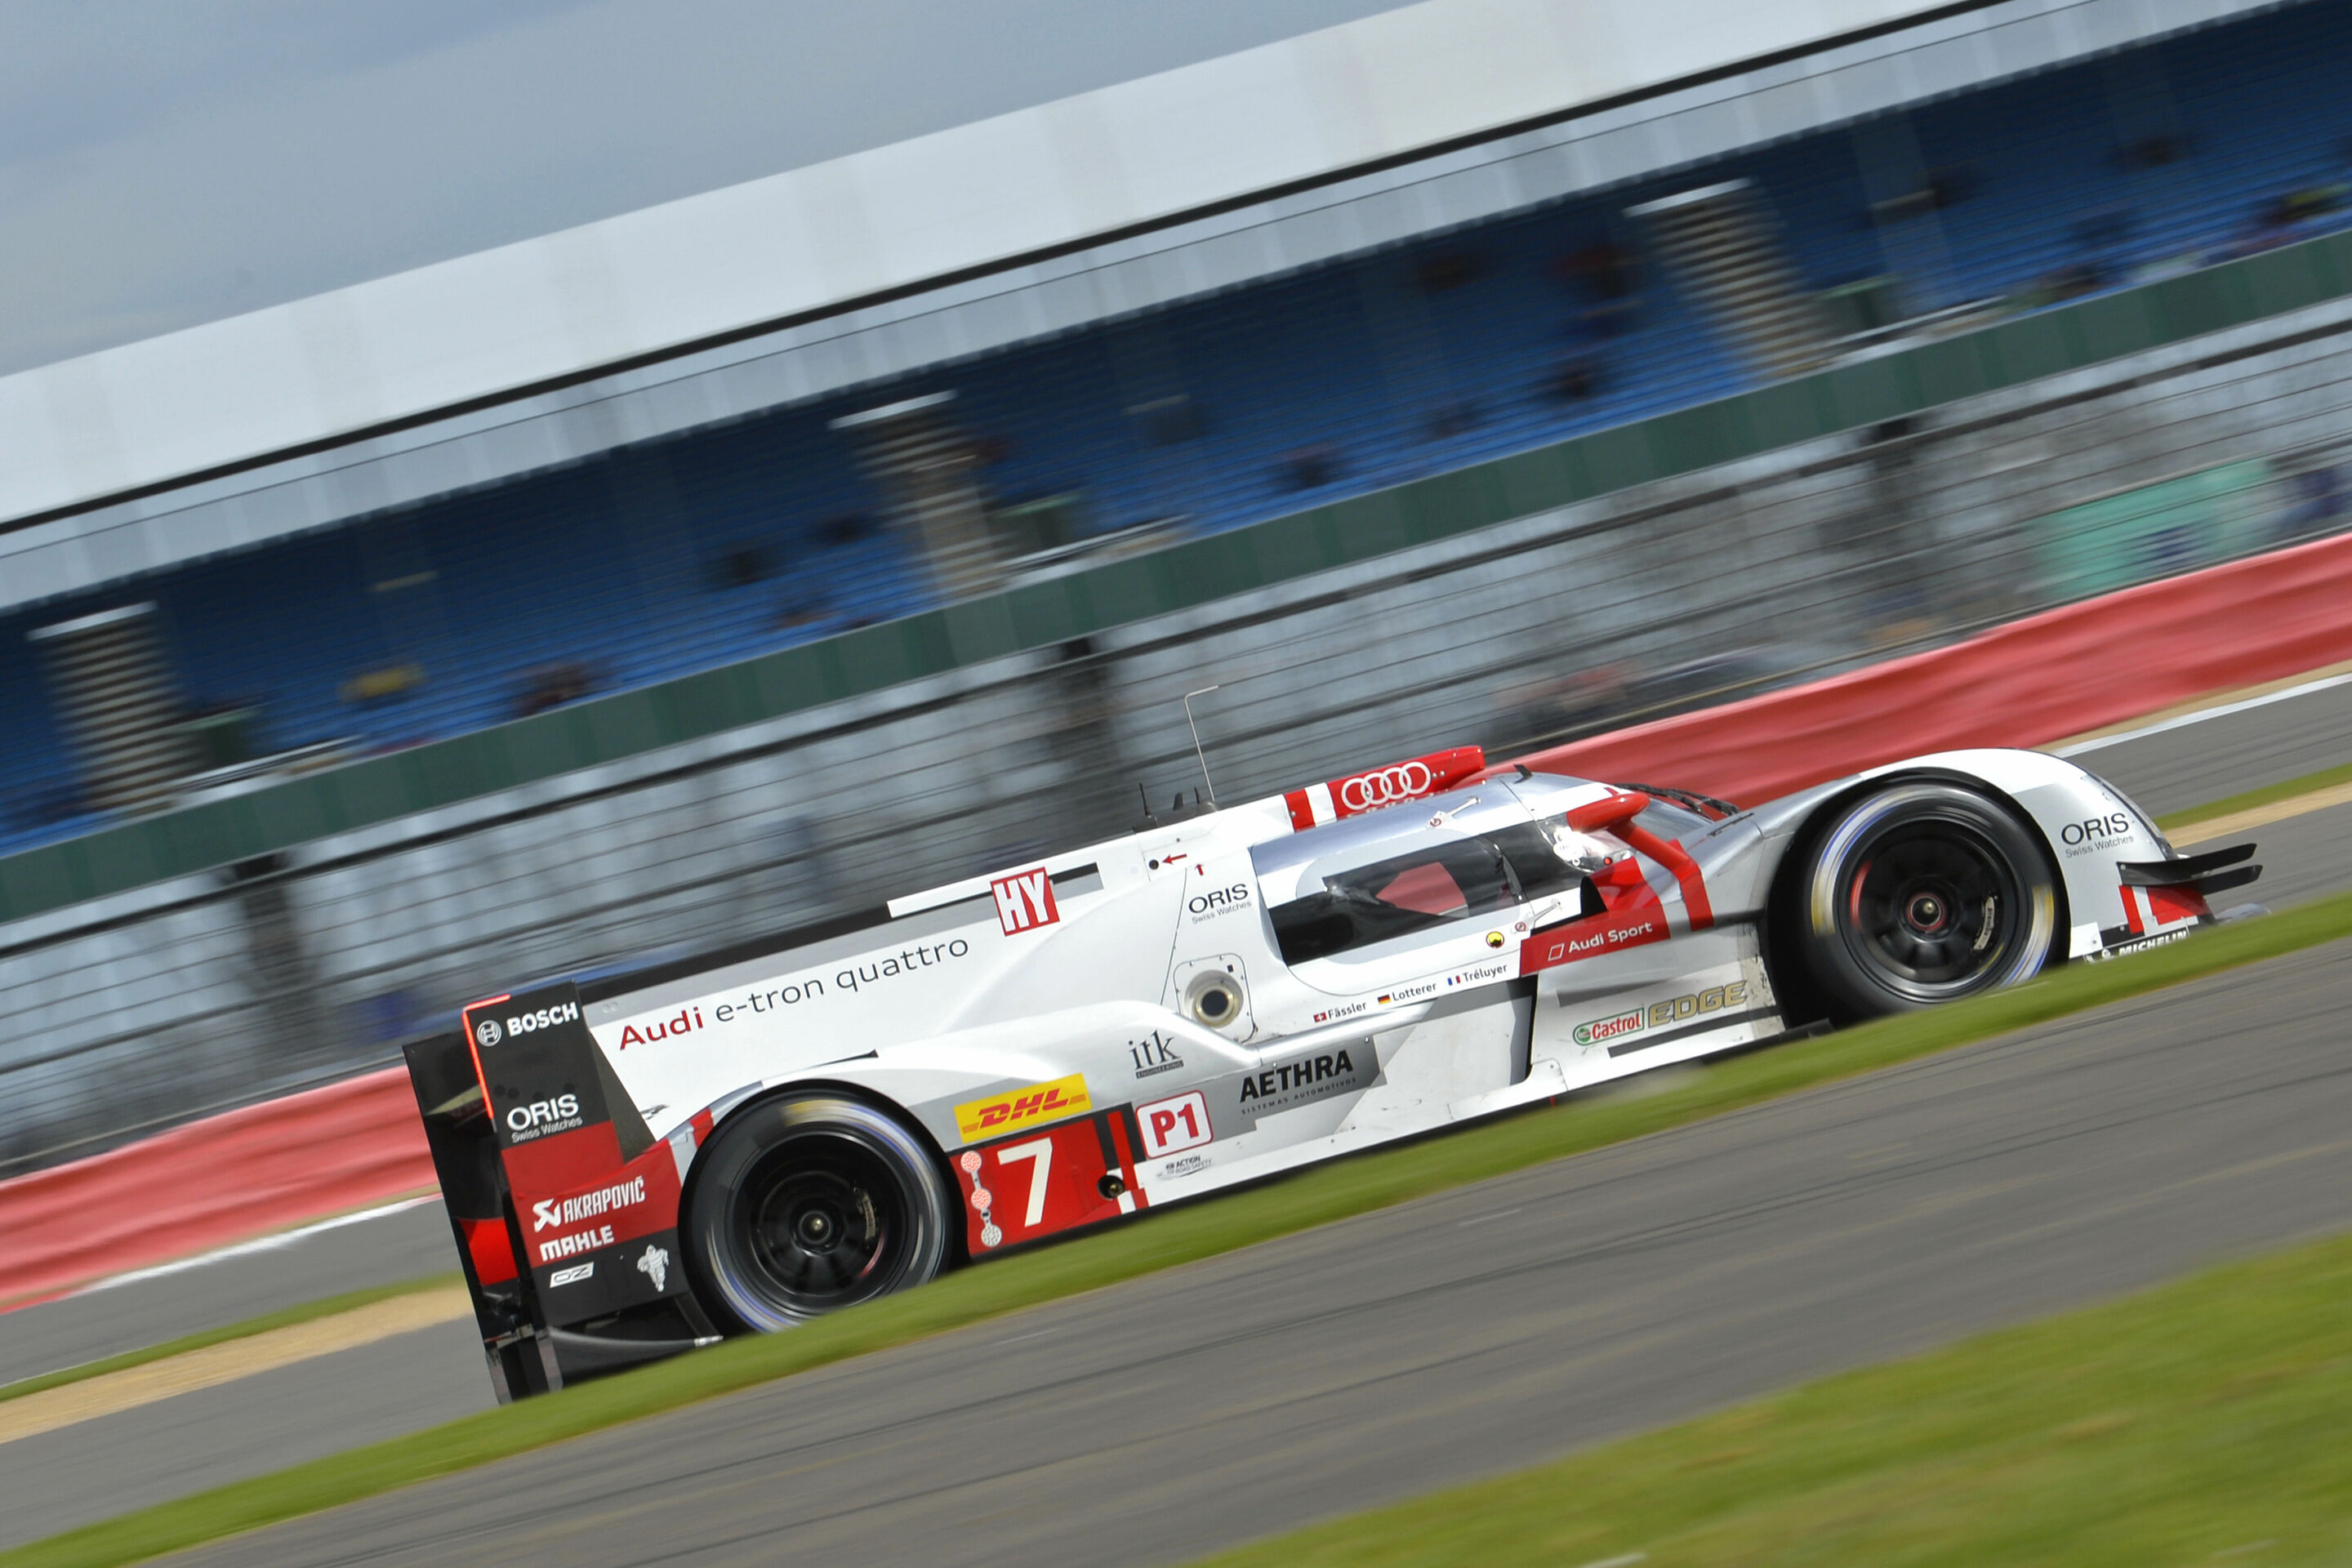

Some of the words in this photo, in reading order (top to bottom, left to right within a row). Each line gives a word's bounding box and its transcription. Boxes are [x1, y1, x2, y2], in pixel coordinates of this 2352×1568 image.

[2060, 813, 2129, 845] ORIS
[993, 871, 1049, 932] HY
[1188, 884, 1249, 913] ORIS
[1568, 933, 1604, 954] Audi
[1607, 921, 1653, 943] Sport
[2118, 930, 2188, 956] MICHELIN
[619, 1006, 705, 1050] Audi
[715, 978, 825, 1022] e-tron
[835, 938, 969, 992] quattro
[1328, 1001, 1366, 1020] Fässler
[1392, 982, 1437, 1002] Lotterer
[1463, 964, 1508, 982] Tréluyer
[1592, 1013, 1642, 1040] Castrol
[1648, 981, 1748, 1028] EDGE
[506, 1001, 579, 1037] BOSCH
[1128, 1030, 1182, 1070] itk
[1240, 1049, 1353, 1102] AETHRA
[506, 1093, 579, 1131] ORIS
[978, 1088, 1069, 1129] DHL
[1241, 1097, 1289, 1116] SISTEMAS
[1294, 1076, 1357, 1100] AUTOMOTIVOS
[1150, 1102, 1200, 1148] P1
[996, 1137, 1054, 1227] 7
[539, 1224, 615, 1263] MAHLE
